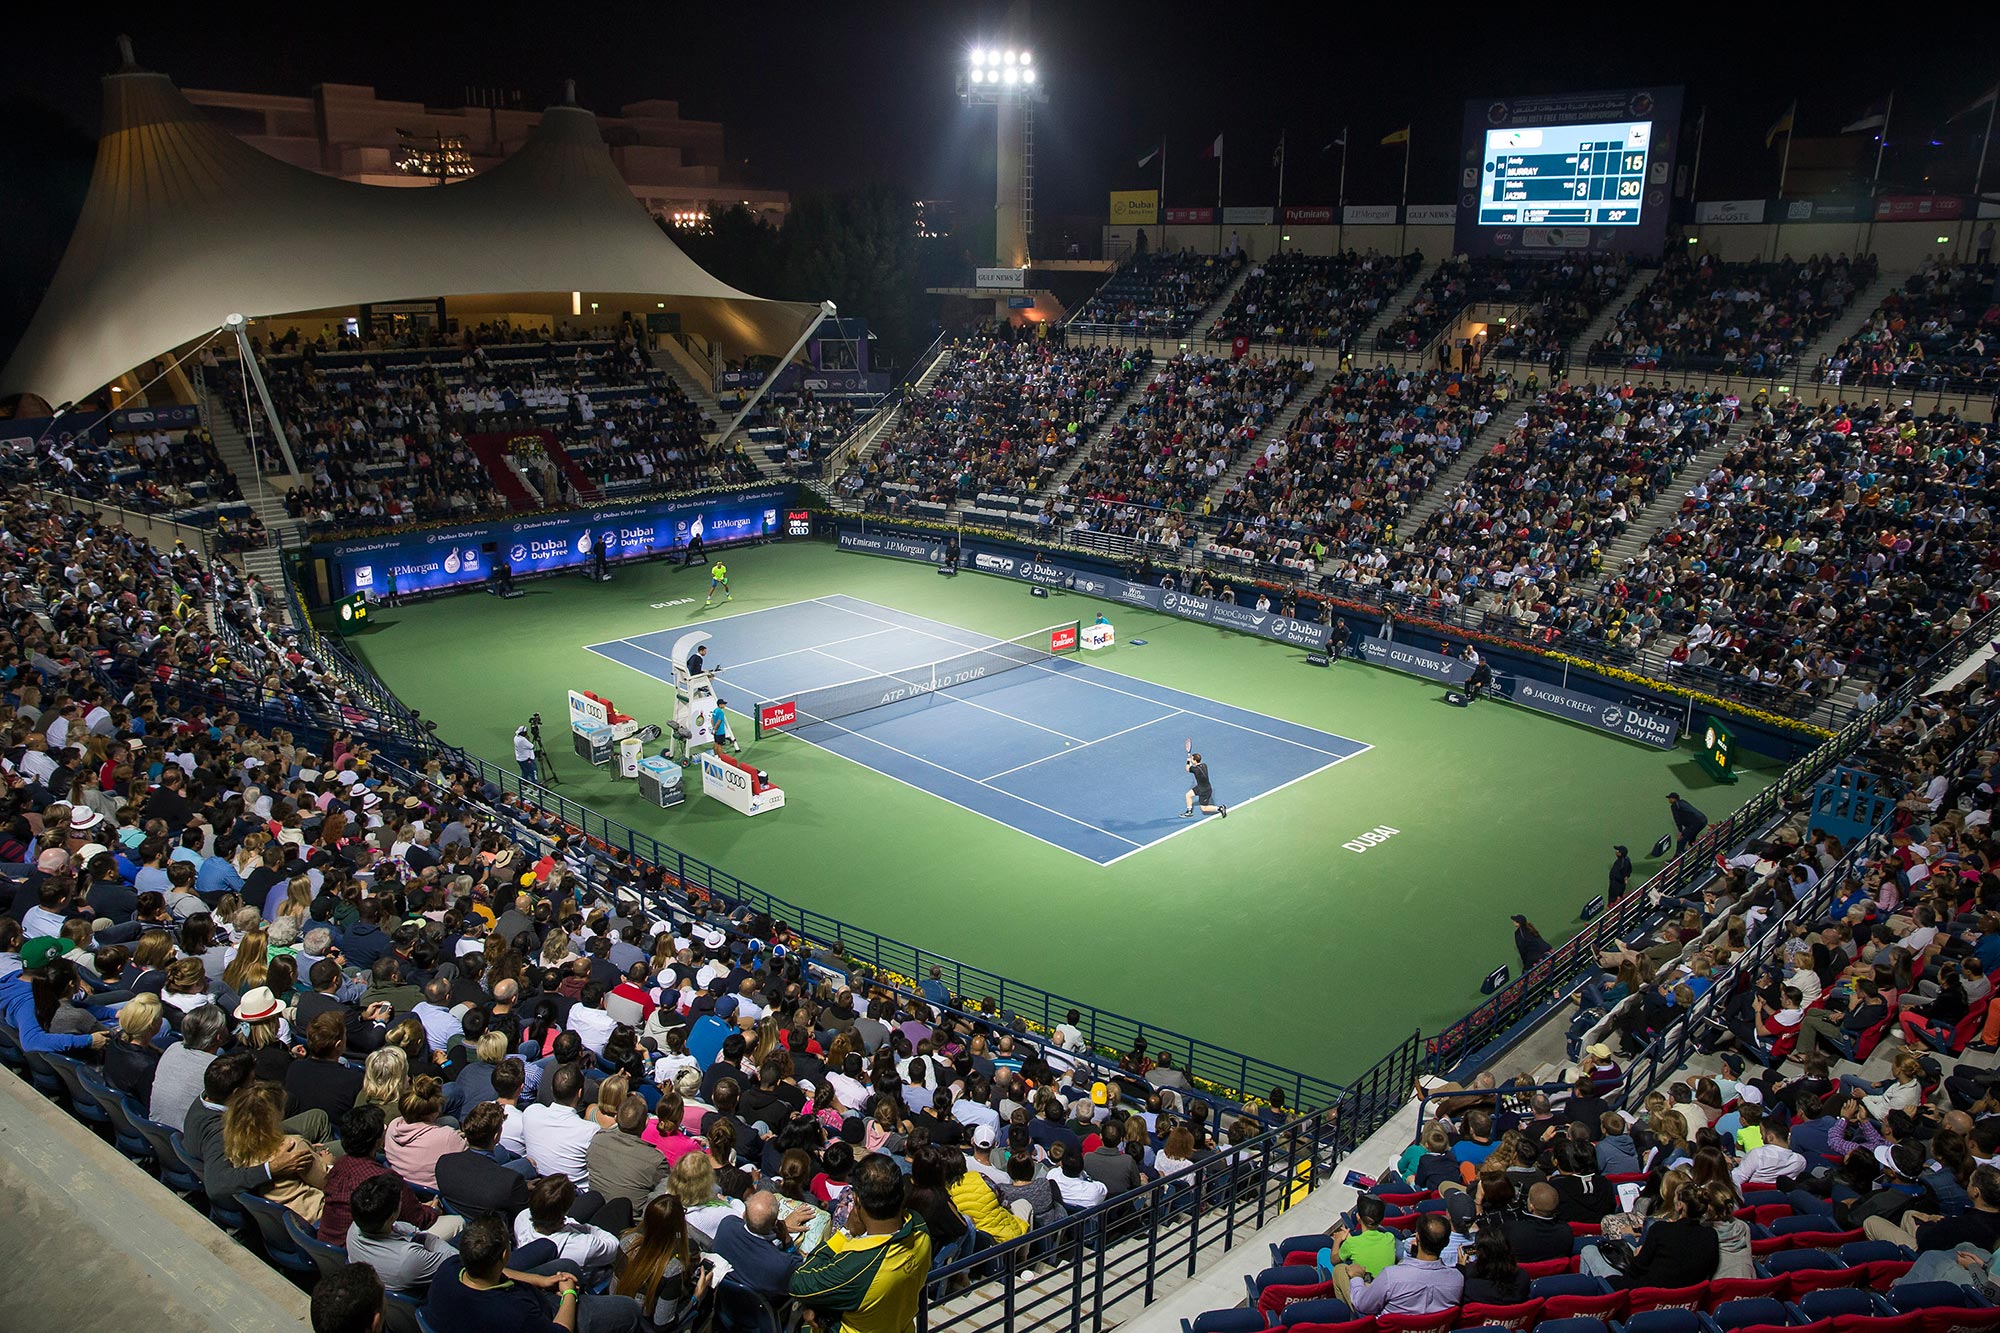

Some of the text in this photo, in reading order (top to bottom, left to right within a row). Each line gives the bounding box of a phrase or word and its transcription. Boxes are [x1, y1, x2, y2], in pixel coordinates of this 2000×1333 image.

[1579, 158, 1590, 172] 4
[1625, 156, 1643, 171] 15
[1577, 183, 1587, 197] 3
[1620, 181, 1640, 196] 30
[1128, 200, 1154, 208] Dubai
[1286, 210, 1330, 220] Fly Emirates
[1707, 212, 1750, 221] LACOSTE
[788, 511, 808, 519] Audi
[712, 518, 751, 529] J.P.Morgan
[621, 528, 654, 539] Dubai
[531, 540, 567, 552] Dubai
[621, 536, 655, 547] Duty Free
[841, 536, 881, 549] Fly Emirates
[531, 549, 568, 560] Duty Free
[884, 541, 925, 556] J.P.Morgan
[387, 562, 439, 577] JP.Morgan
[1032, 573, 1046, 582] Duty
[650, 597, 696, 609] DUBAI
[1180, 595, 1209, 610] Dubai
[1177, 605, 1206, 618] Duty Free
[1289, 620, 1322, 638] Dubai
[1053, 637, 1074, 648] Emirates
[1093, 632, 1113, 645] FedEx
[1287, 631, 1319, 645] Duty Free
[1369, 643, 1387, 653] Dubai
[1308, 655, 1326, 664] LACOSTE
[1390, 650, 1440, 671] GULF NEWS
[881, 666, 986, 704] ATP WORLD TOUR
[1533, 689, 1594, 713] JACOB'S CREEK
[774, 708, 784, 717] Fly
[764, 712, 794, 727] Emirates
[1626, 710, 1670, 735] Dubai
[1624, 724, 1666, 745] Duty Free
[1341, 824, 1400, 853] DUBAI
